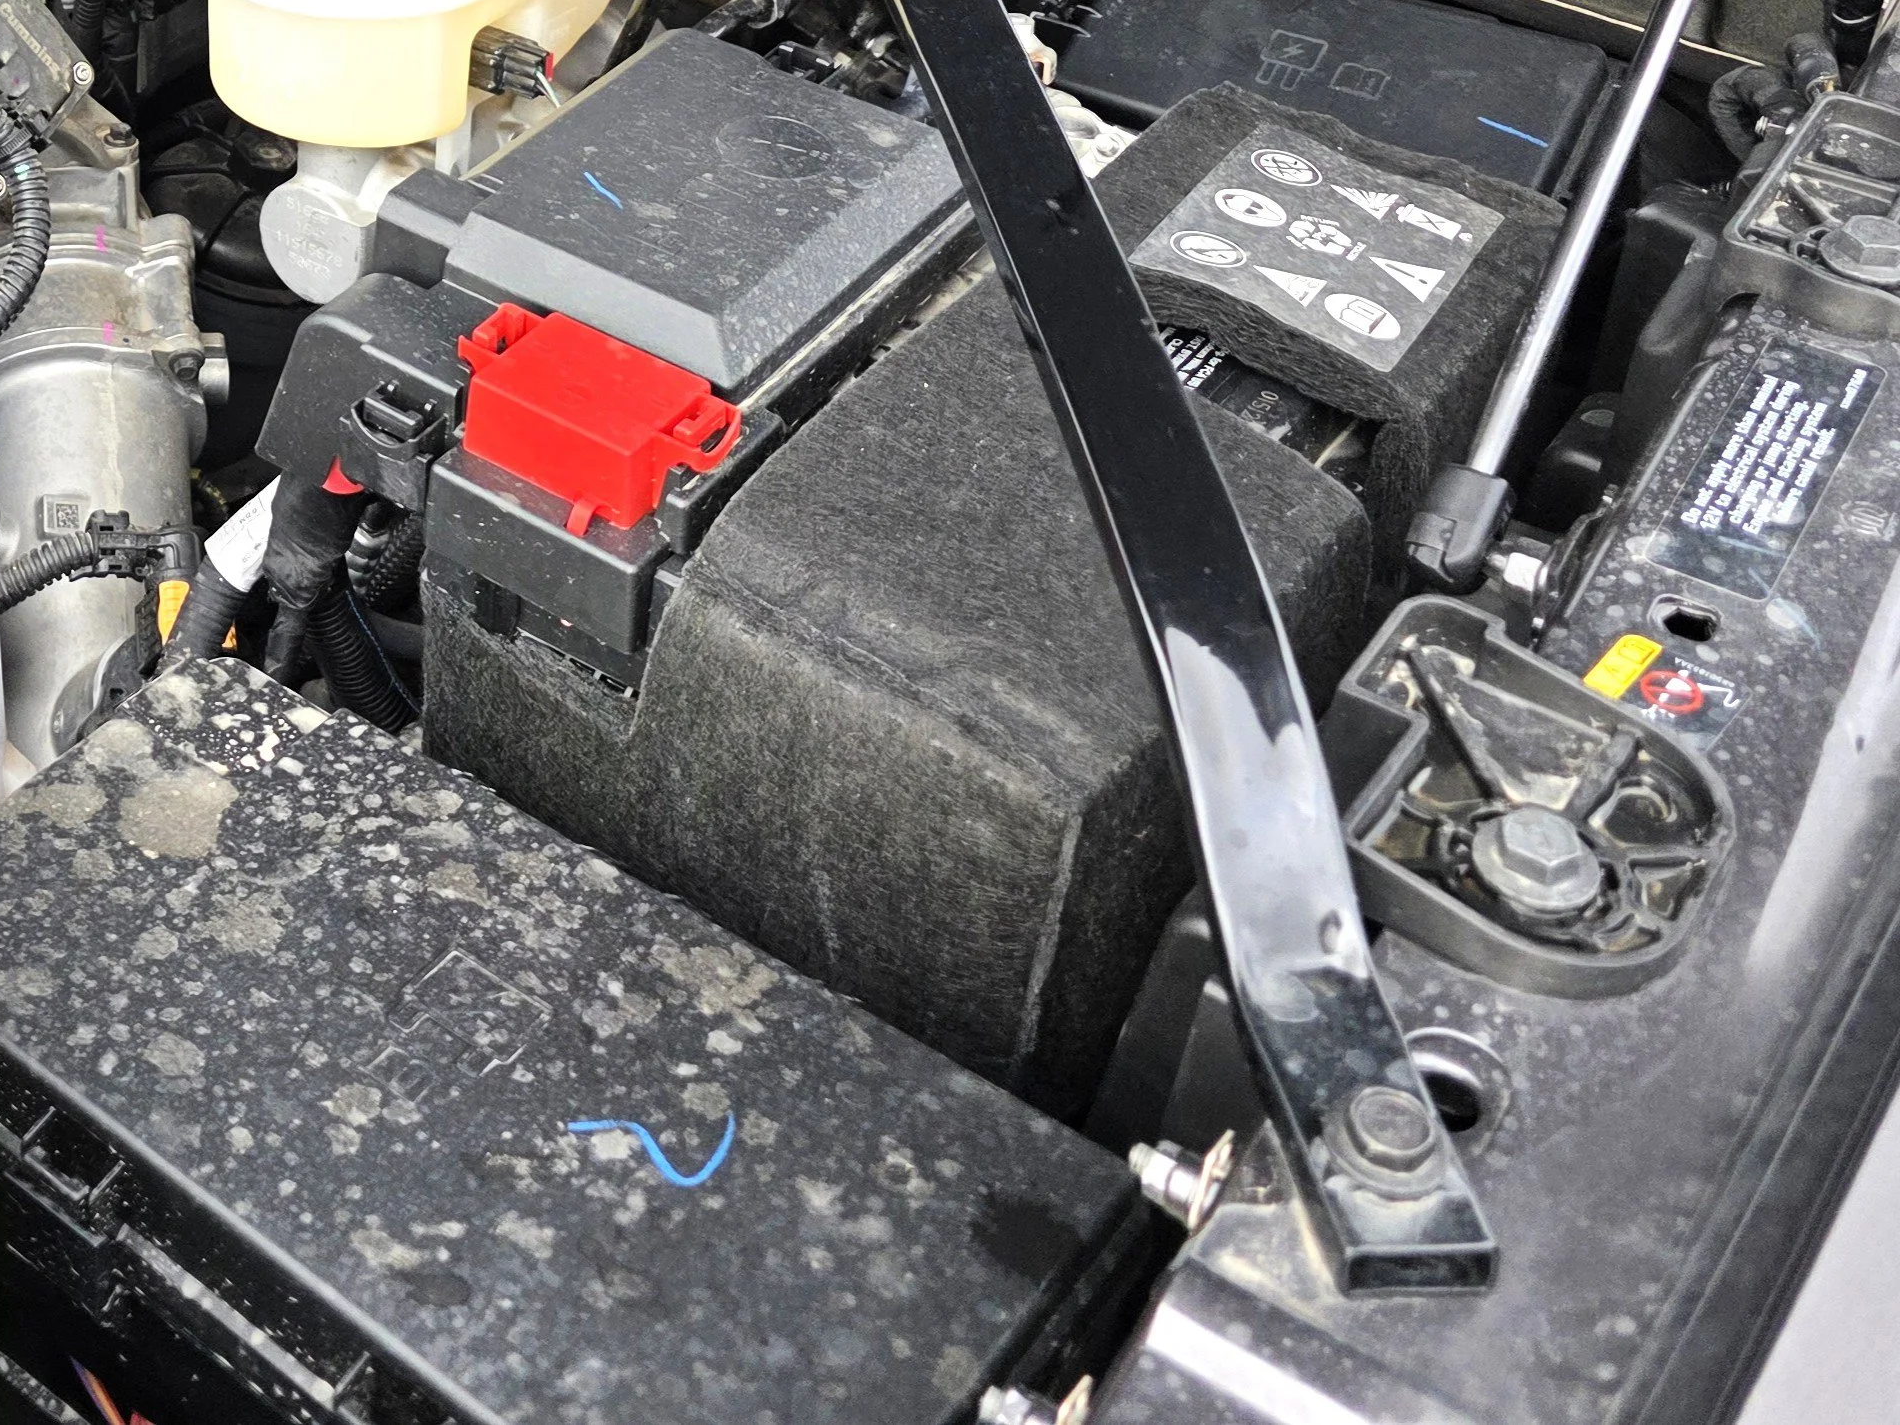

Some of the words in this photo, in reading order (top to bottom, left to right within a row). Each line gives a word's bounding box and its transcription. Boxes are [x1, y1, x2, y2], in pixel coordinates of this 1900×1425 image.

[1681, 507, 1702, 524] Do
[1694, 487, 1714, 506] not
[1705, 460, 1733, 488] apply
[1722, 434, 1744, 460] more
[1734, 410, 1758, 435] than
[1699, 505, 1724, 529] 12V
[1714, 493, 1733, 507] to
[1724, 444, 1760, 493] electrical
[1751, 410, 1780, 446] system
[1769, 380, 1801, 411] during
[1742, 498, 1774, 535] Engine
[1766, 476, 1786, 499] and
[1777, 436, 1812, 479] starting
[1800, 402, 1828, 438] system
[1755, 465, 1769, 479] or
[1758, 441, 1786, 468] jump
[1728, 479, 1766, 524] charging
